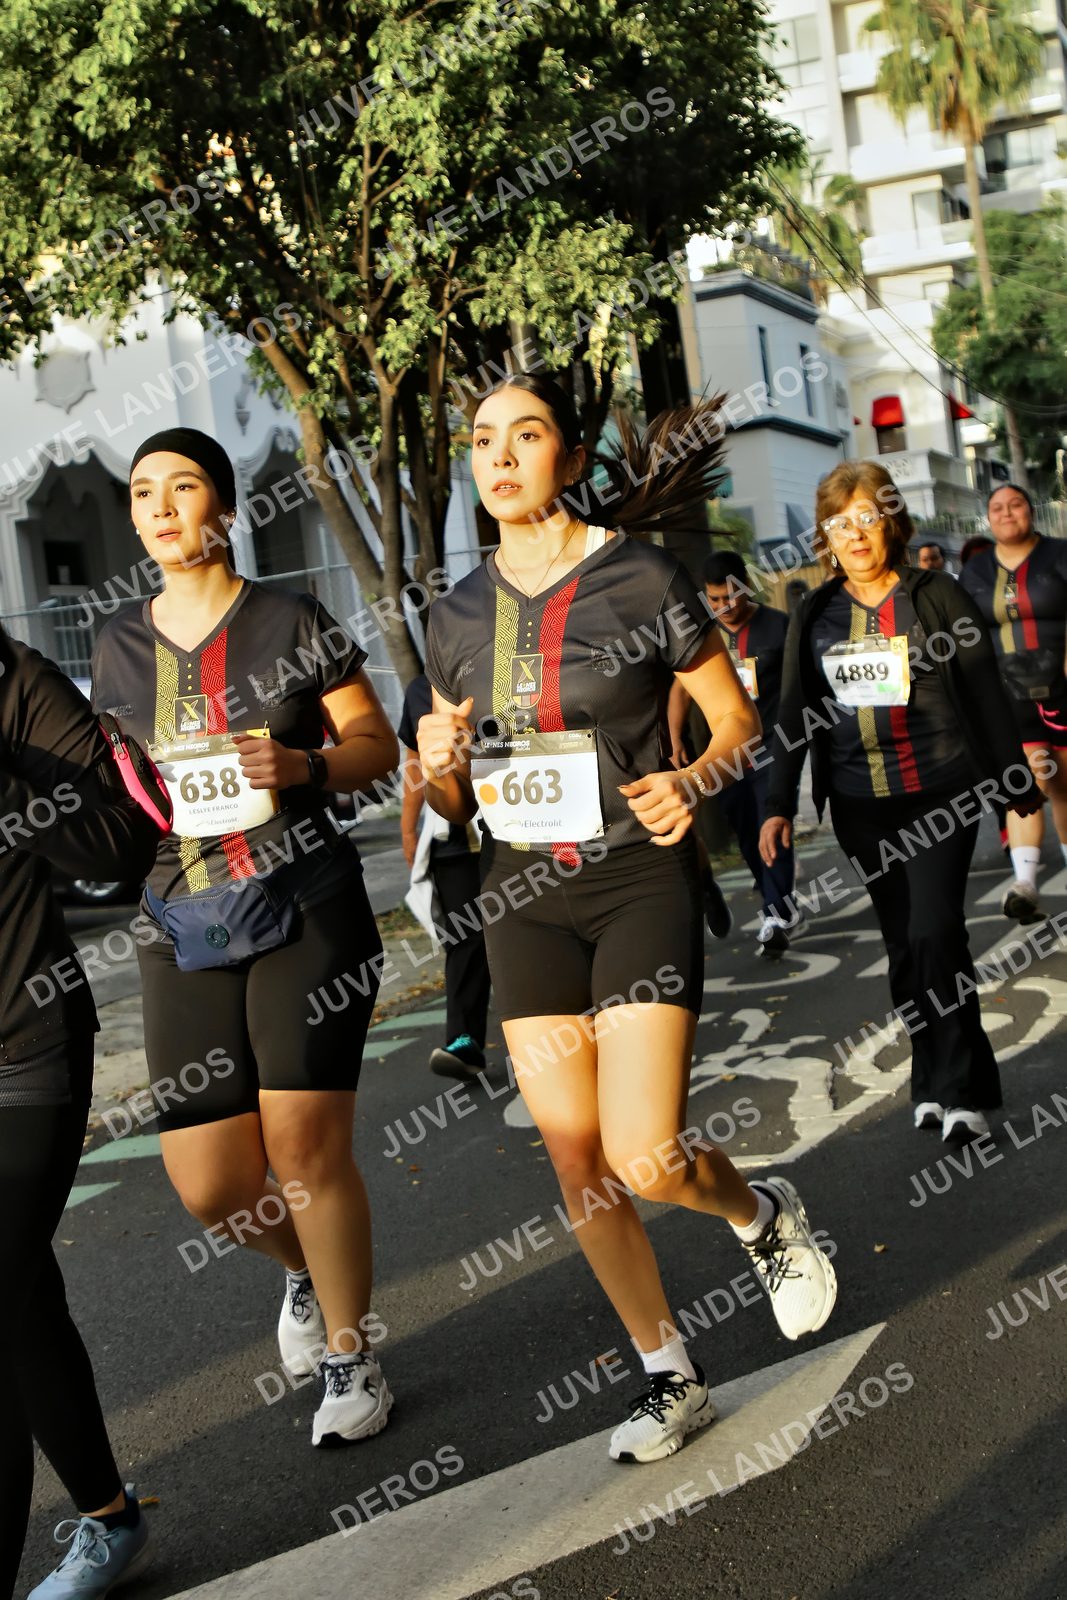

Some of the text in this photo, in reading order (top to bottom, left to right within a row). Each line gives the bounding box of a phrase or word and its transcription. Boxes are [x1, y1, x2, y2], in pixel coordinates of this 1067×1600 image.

[835, 661, 889, 684] 4889
[180, 766, 240, 804] 638
[502, 768, 563, 806] 663
[212, 803, 239, 812] FRANCO
